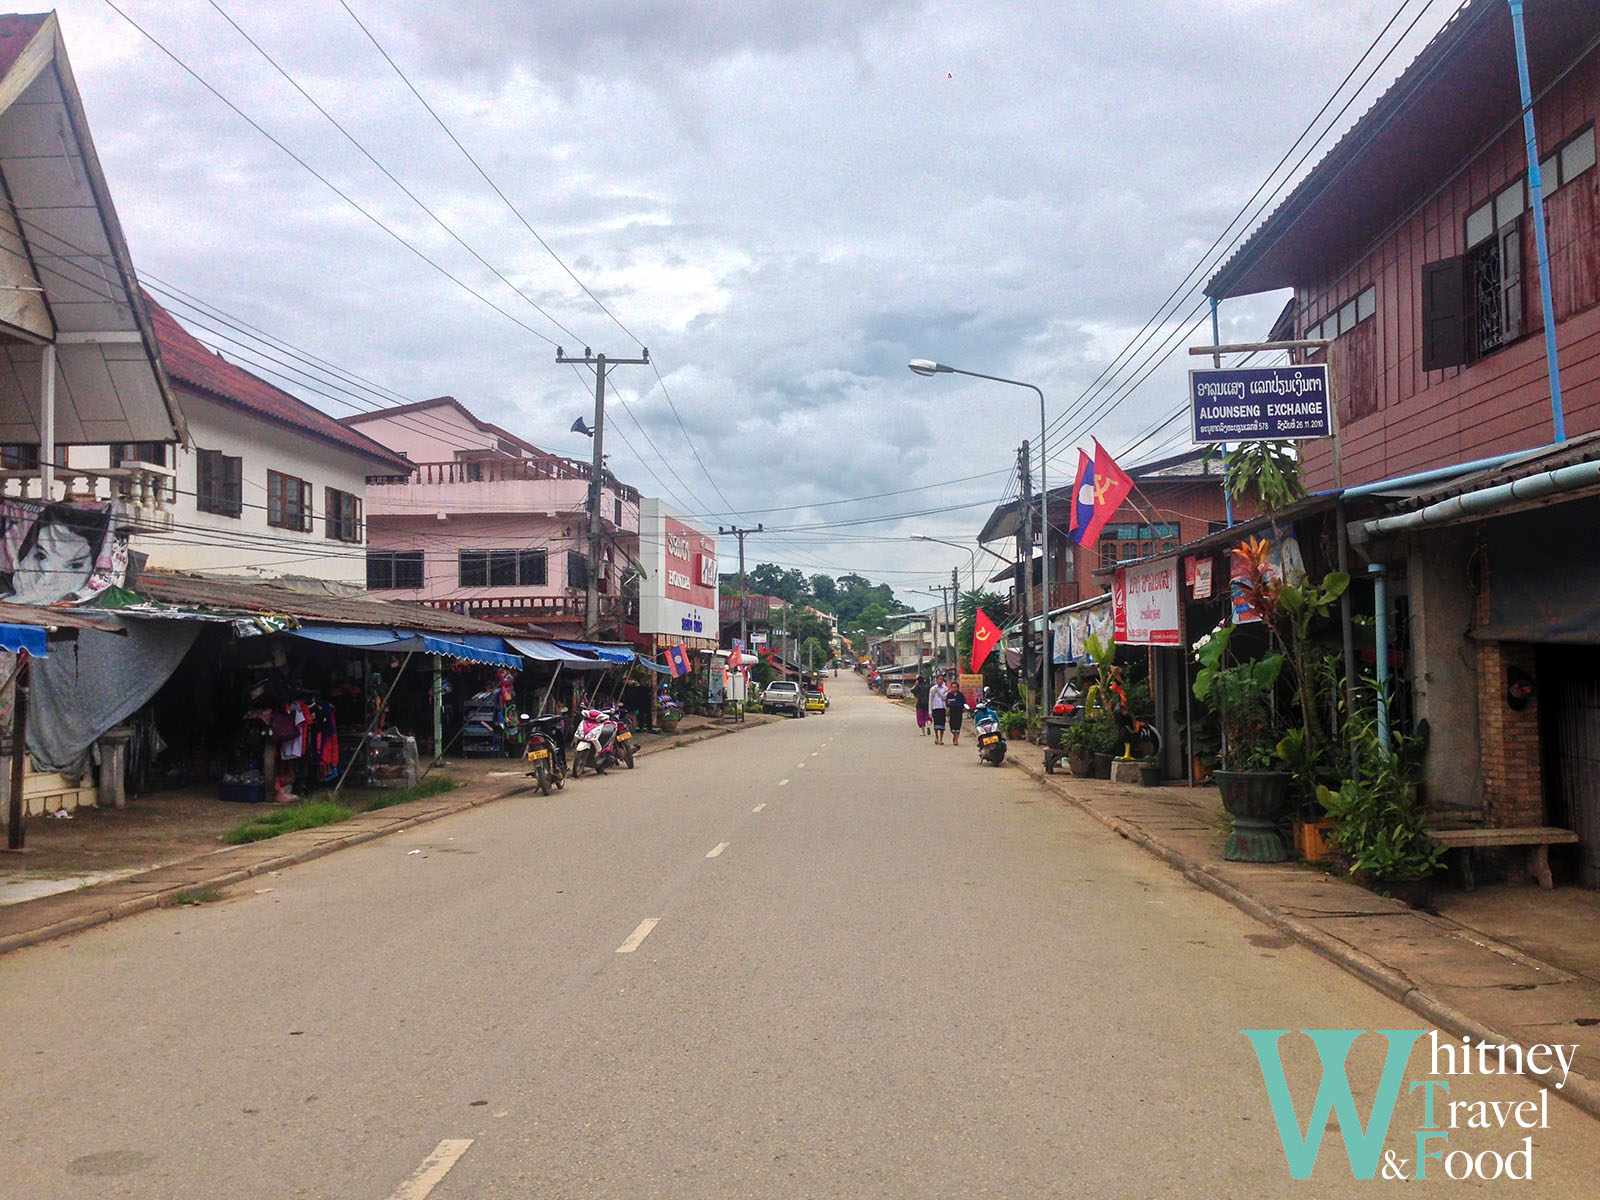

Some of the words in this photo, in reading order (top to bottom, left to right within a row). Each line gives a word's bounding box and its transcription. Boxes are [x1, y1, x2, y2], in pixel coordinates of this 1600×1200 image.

[1250, 371, 1321, 397] ແລກປ່ຽນເງິນຕາ
[1200, 405, 1260, 419] ALOUNSENG
[1267, 402, 1322, 416] EXCHANGE
[1259, 422, 1269, 431] 578
[668, 570, 691, 590] HONDA
